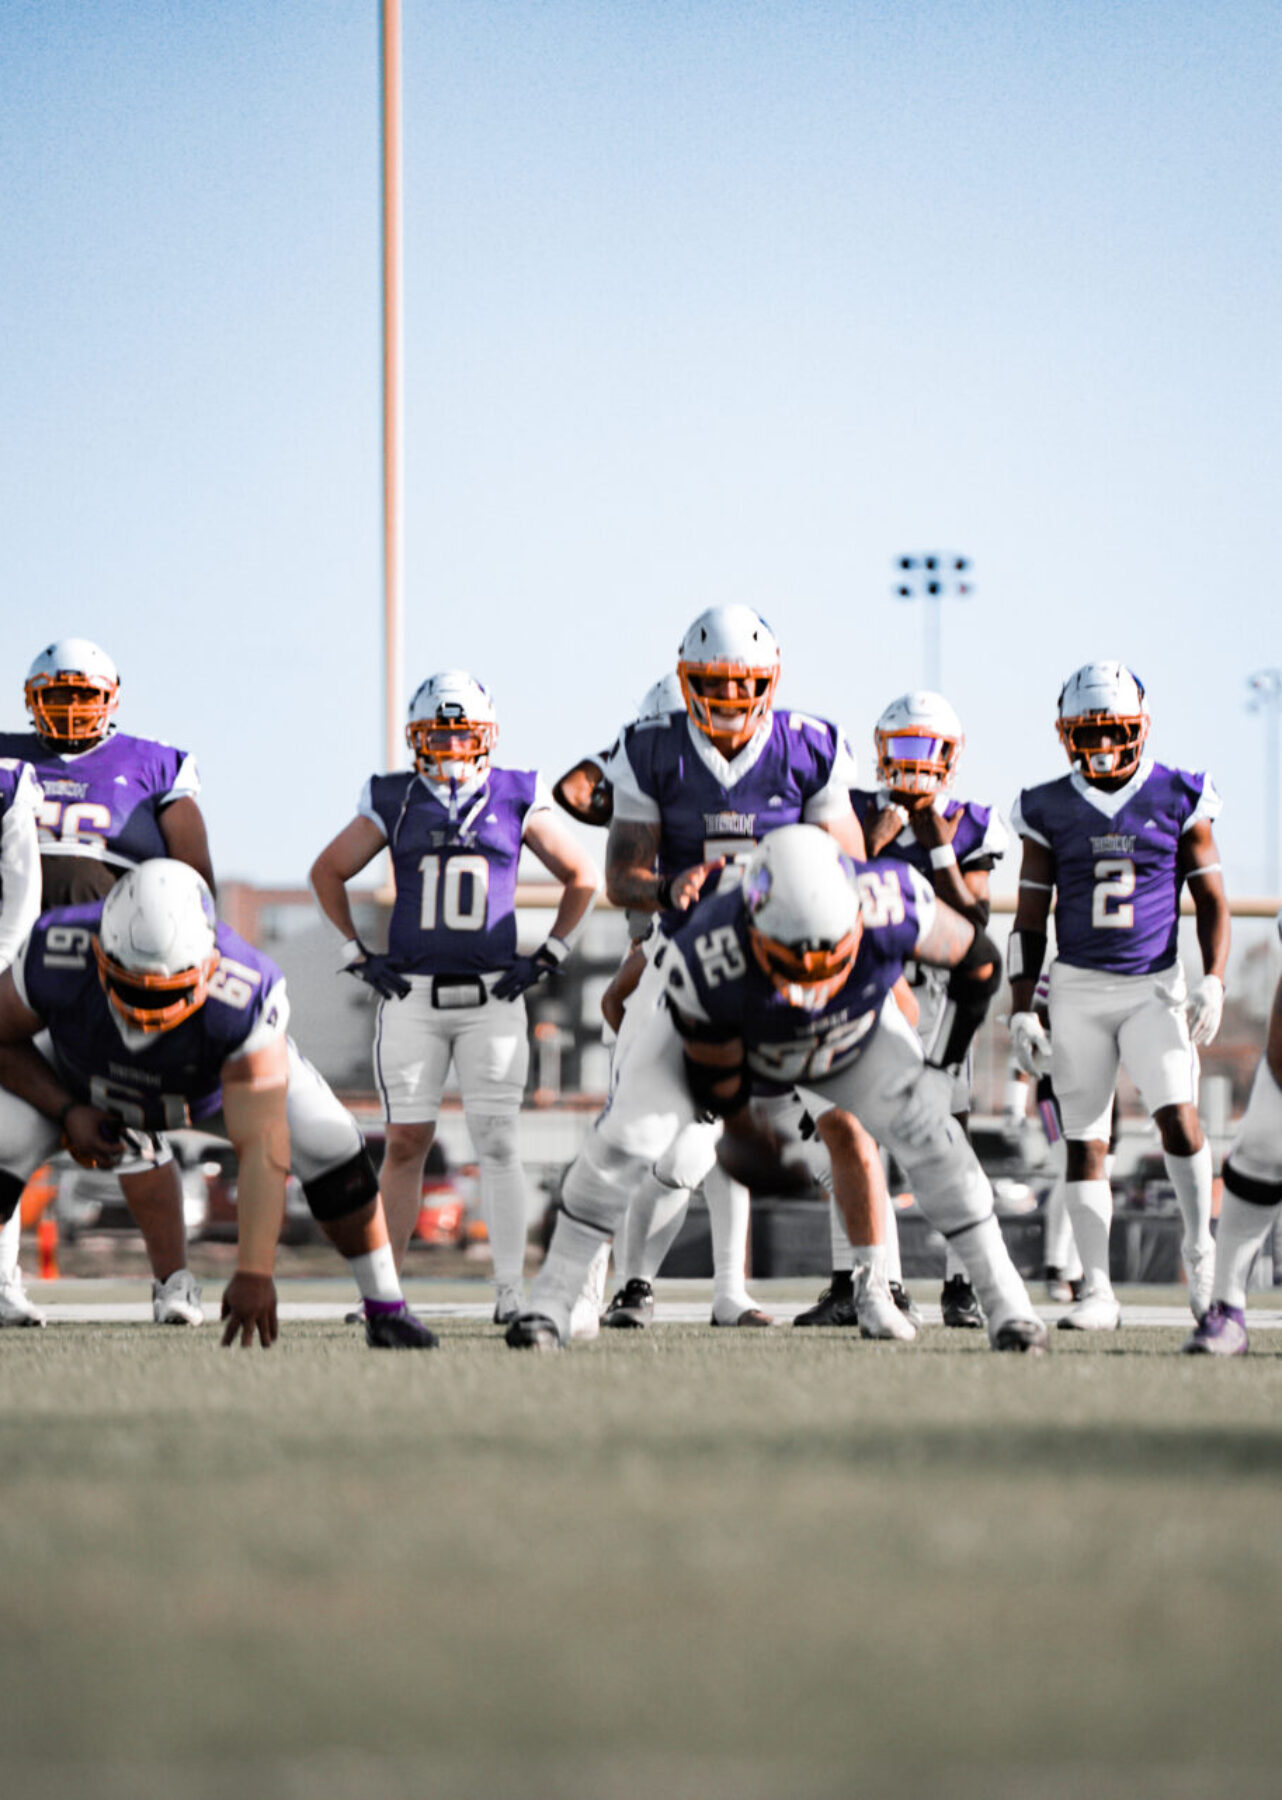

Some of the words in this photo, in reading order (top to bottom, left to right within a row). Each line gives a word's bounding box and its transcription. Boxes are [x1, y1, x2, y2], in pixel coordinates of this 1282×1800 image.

[418, 854, 489, 931] 10
[857, 869, 906, 929] 52
[1092, 858, 1136, 929] 2
[42, 925, 91, 970] 61
[694, 924, 748, 990] 52
[207, 956, 262, 1011] 61
